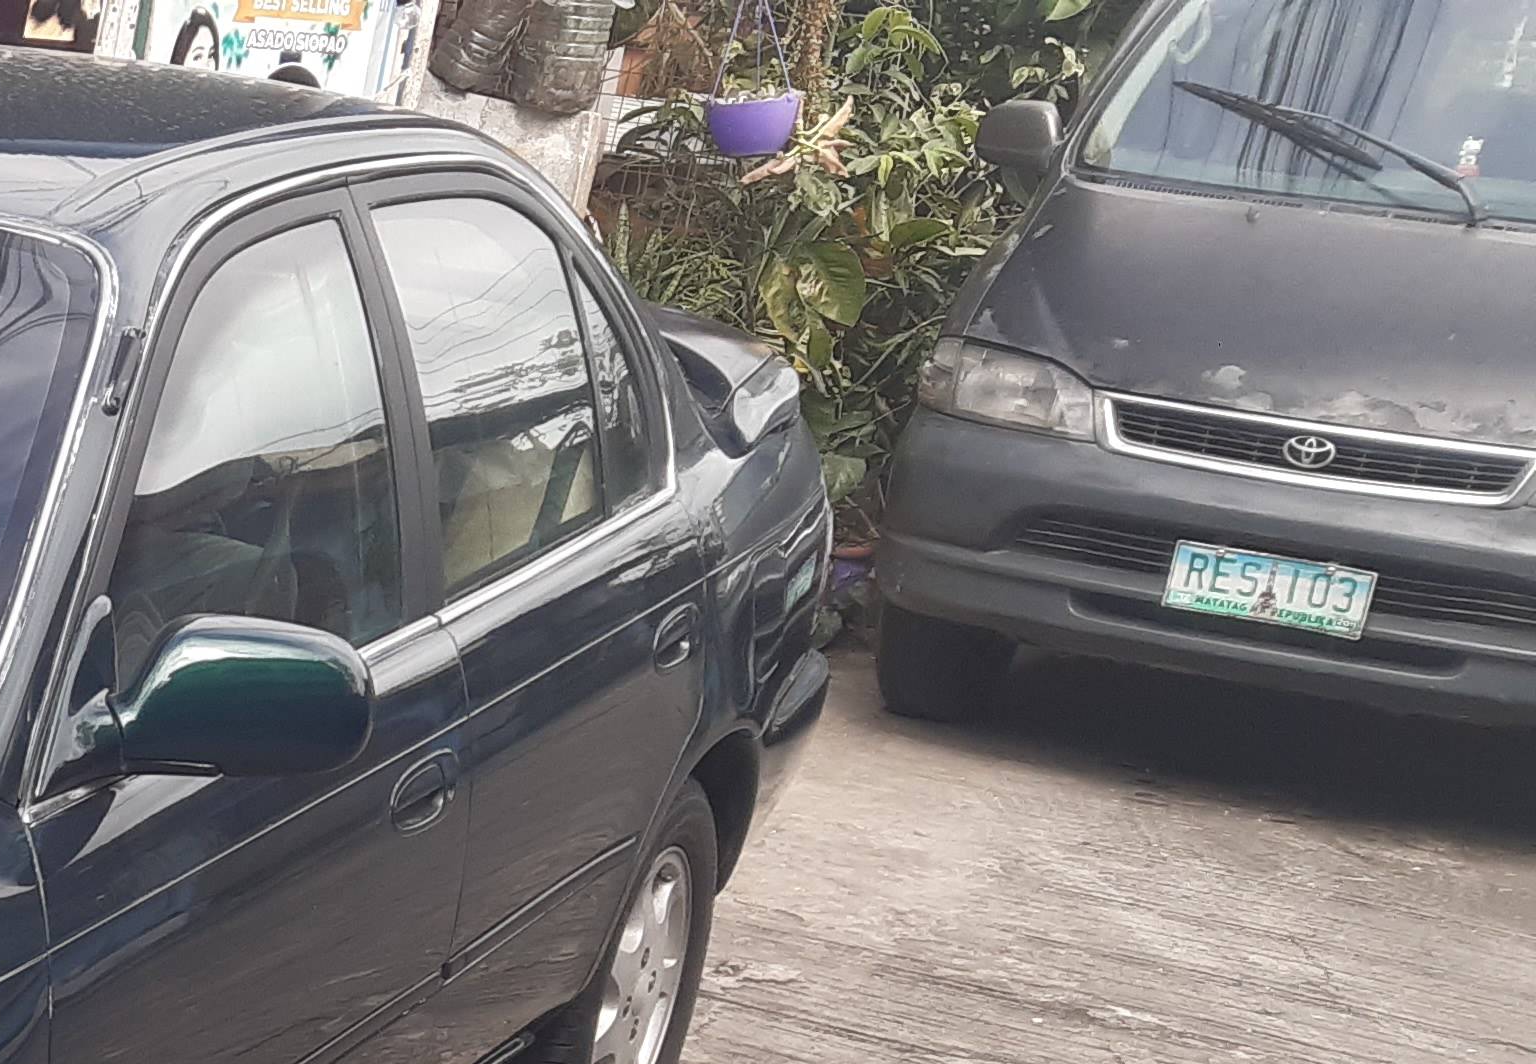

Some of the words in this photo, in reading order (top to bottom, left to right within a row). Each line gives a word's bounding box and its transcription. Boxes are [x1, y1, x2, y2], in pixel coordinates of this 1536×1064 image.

[246, 29, 295, 51] ASADO
[295, 32, 348, 55] SIOPAO
[1183, 552, 1261, 597] RES
[1194, 594, 1248, 612] MATATAG
